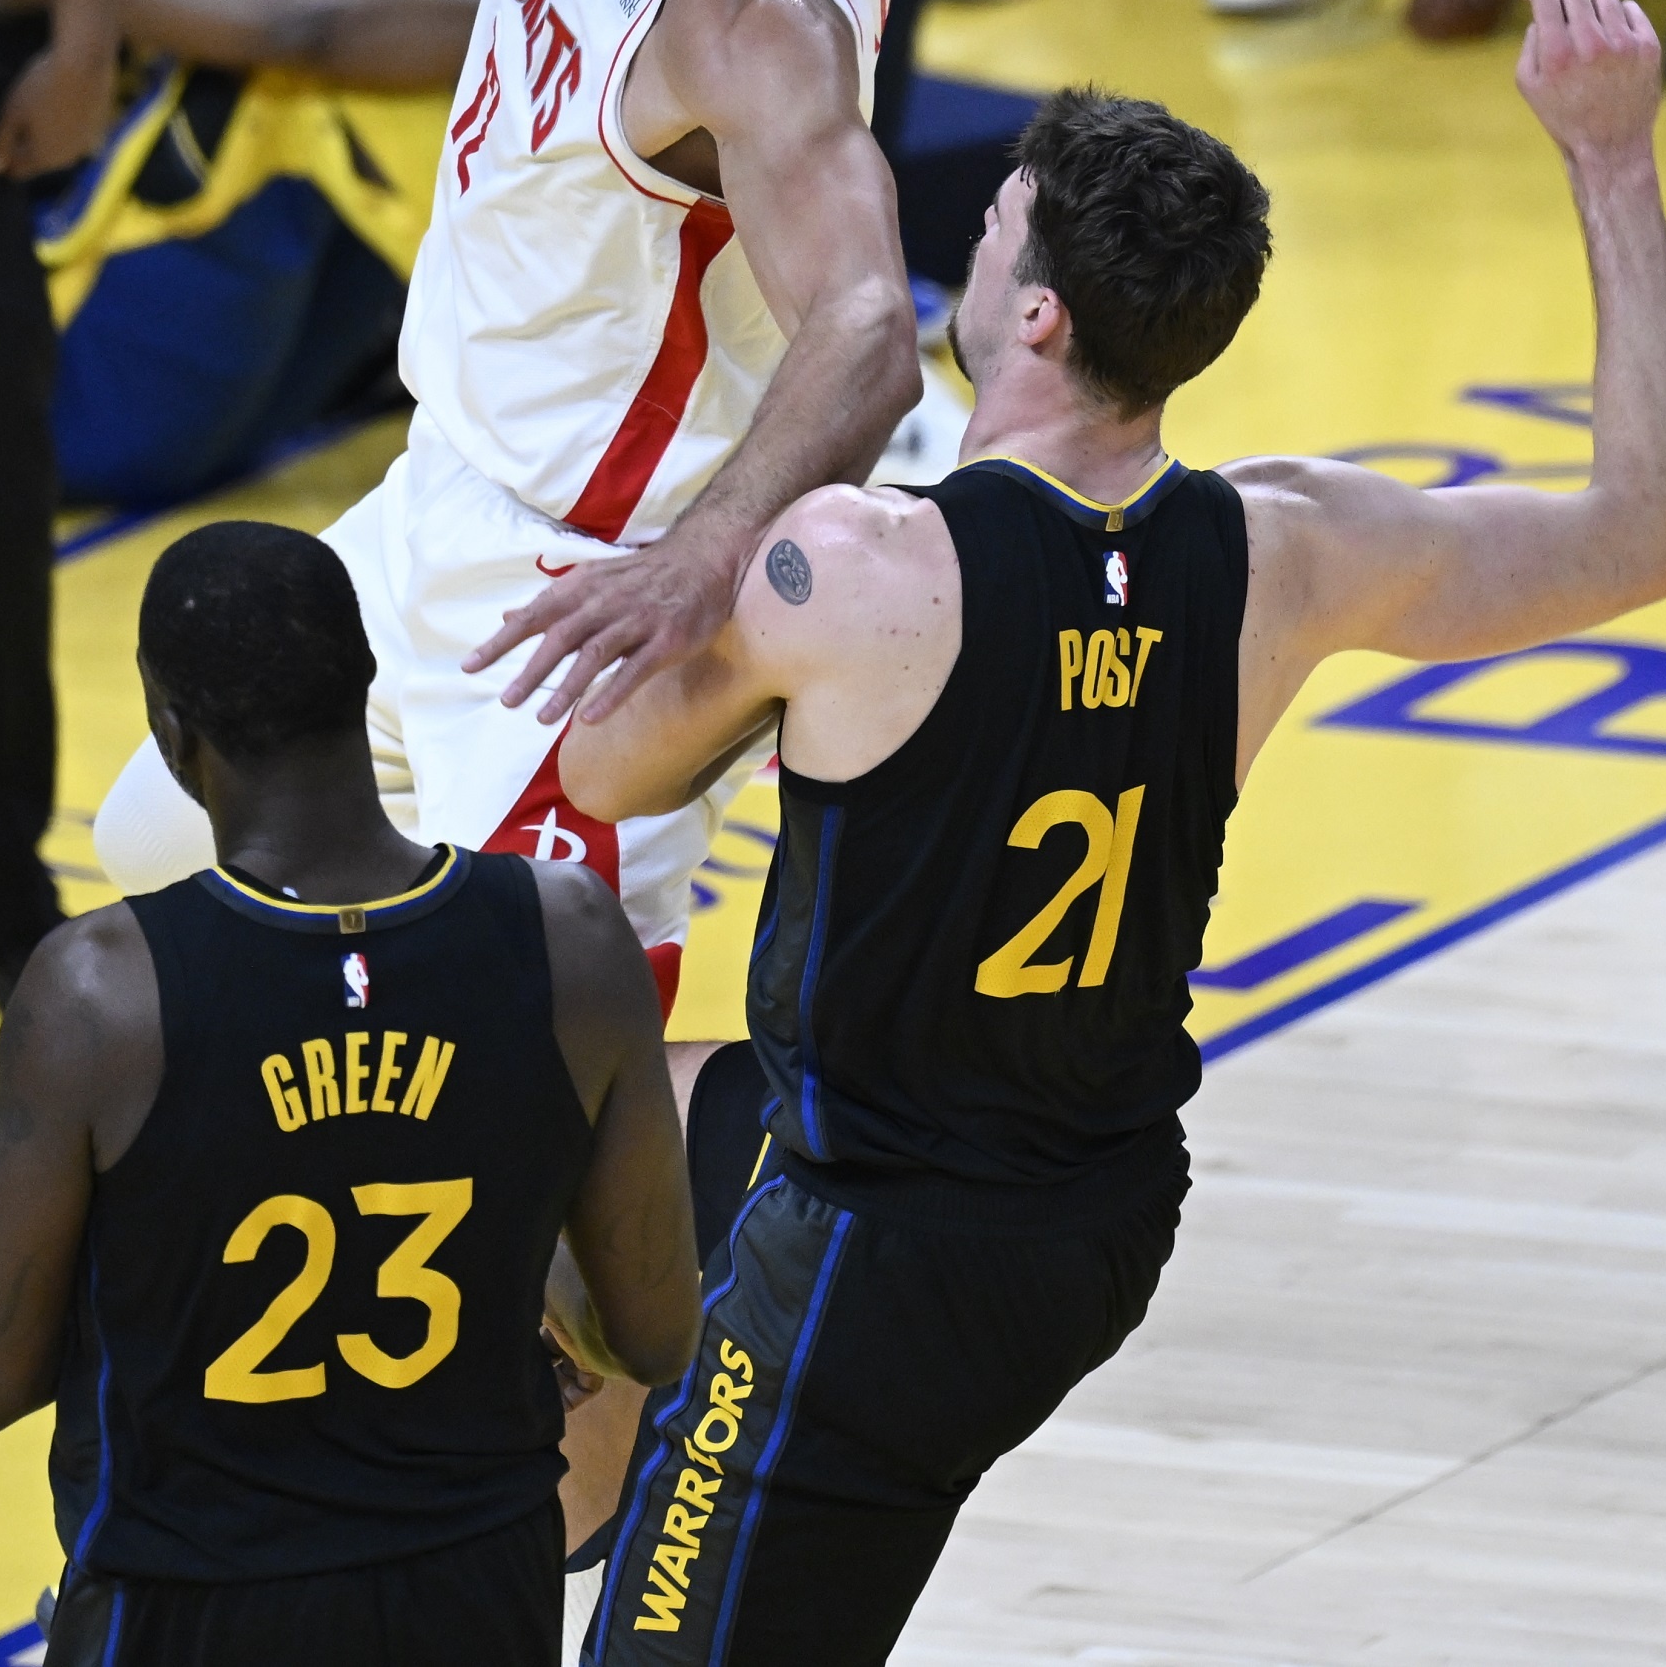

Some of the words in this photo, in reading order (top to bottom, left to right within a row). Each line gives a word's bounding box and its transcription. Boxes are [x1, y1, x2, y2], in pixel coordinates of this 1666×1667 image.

[1058, 625, 1164, 711] POST
[974, 783, 1146, 999] 21
[260, 1030, 456, 1133] GREEN
[203, 1177, 474, 1404] 23
[634, 1337, 755, 1634] WARRIORS
